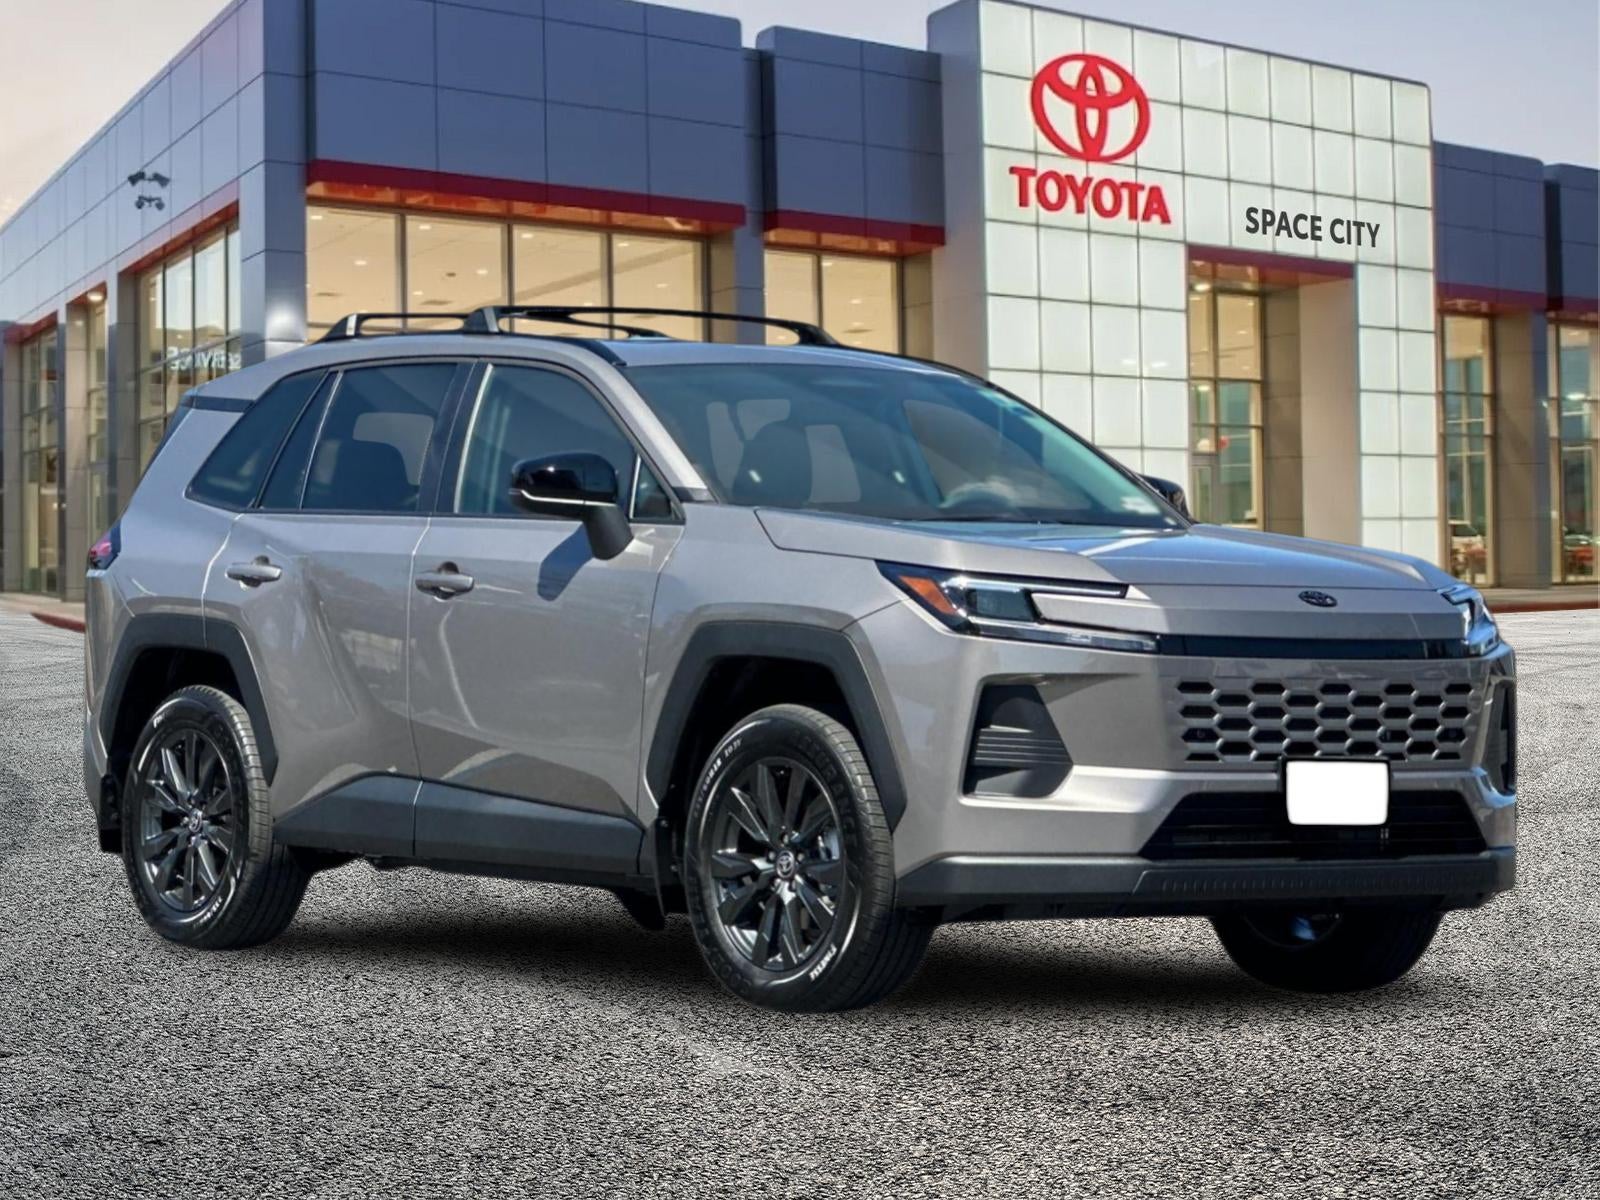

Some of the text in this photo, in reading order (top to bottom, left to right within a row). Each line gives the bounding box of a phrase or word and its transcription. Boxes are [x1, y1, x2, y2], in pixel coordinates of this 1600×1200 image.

[1009, 165, 1171, 224] TOYOTA
[1245, 206, 1381, 248] SPACE CITY
